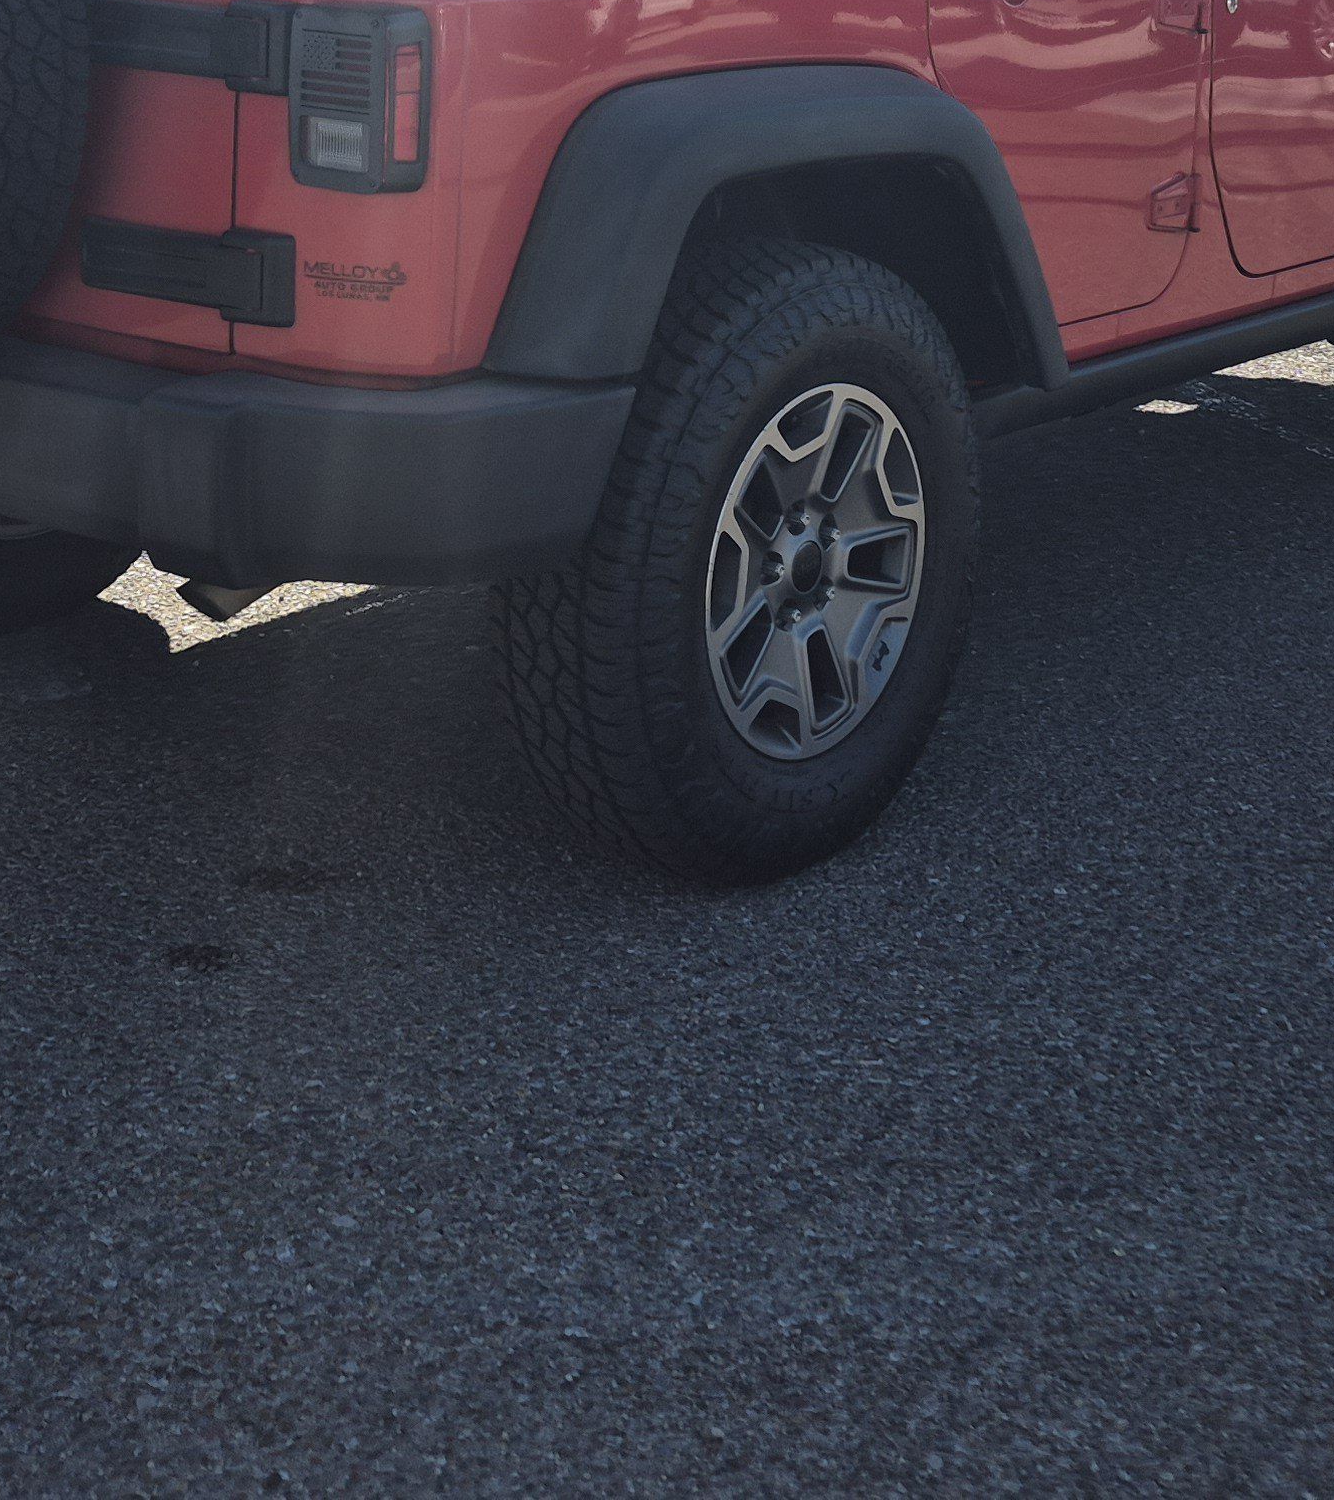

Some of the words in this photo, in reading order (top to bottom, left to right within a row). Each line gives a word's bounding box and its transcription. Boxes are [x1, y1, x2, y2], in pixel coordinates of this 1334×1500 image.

[303, 260, 379, 278] MELLOY
[314, 280, 347, 291] AUTO
[350, 282, 394, 293] GROUP
